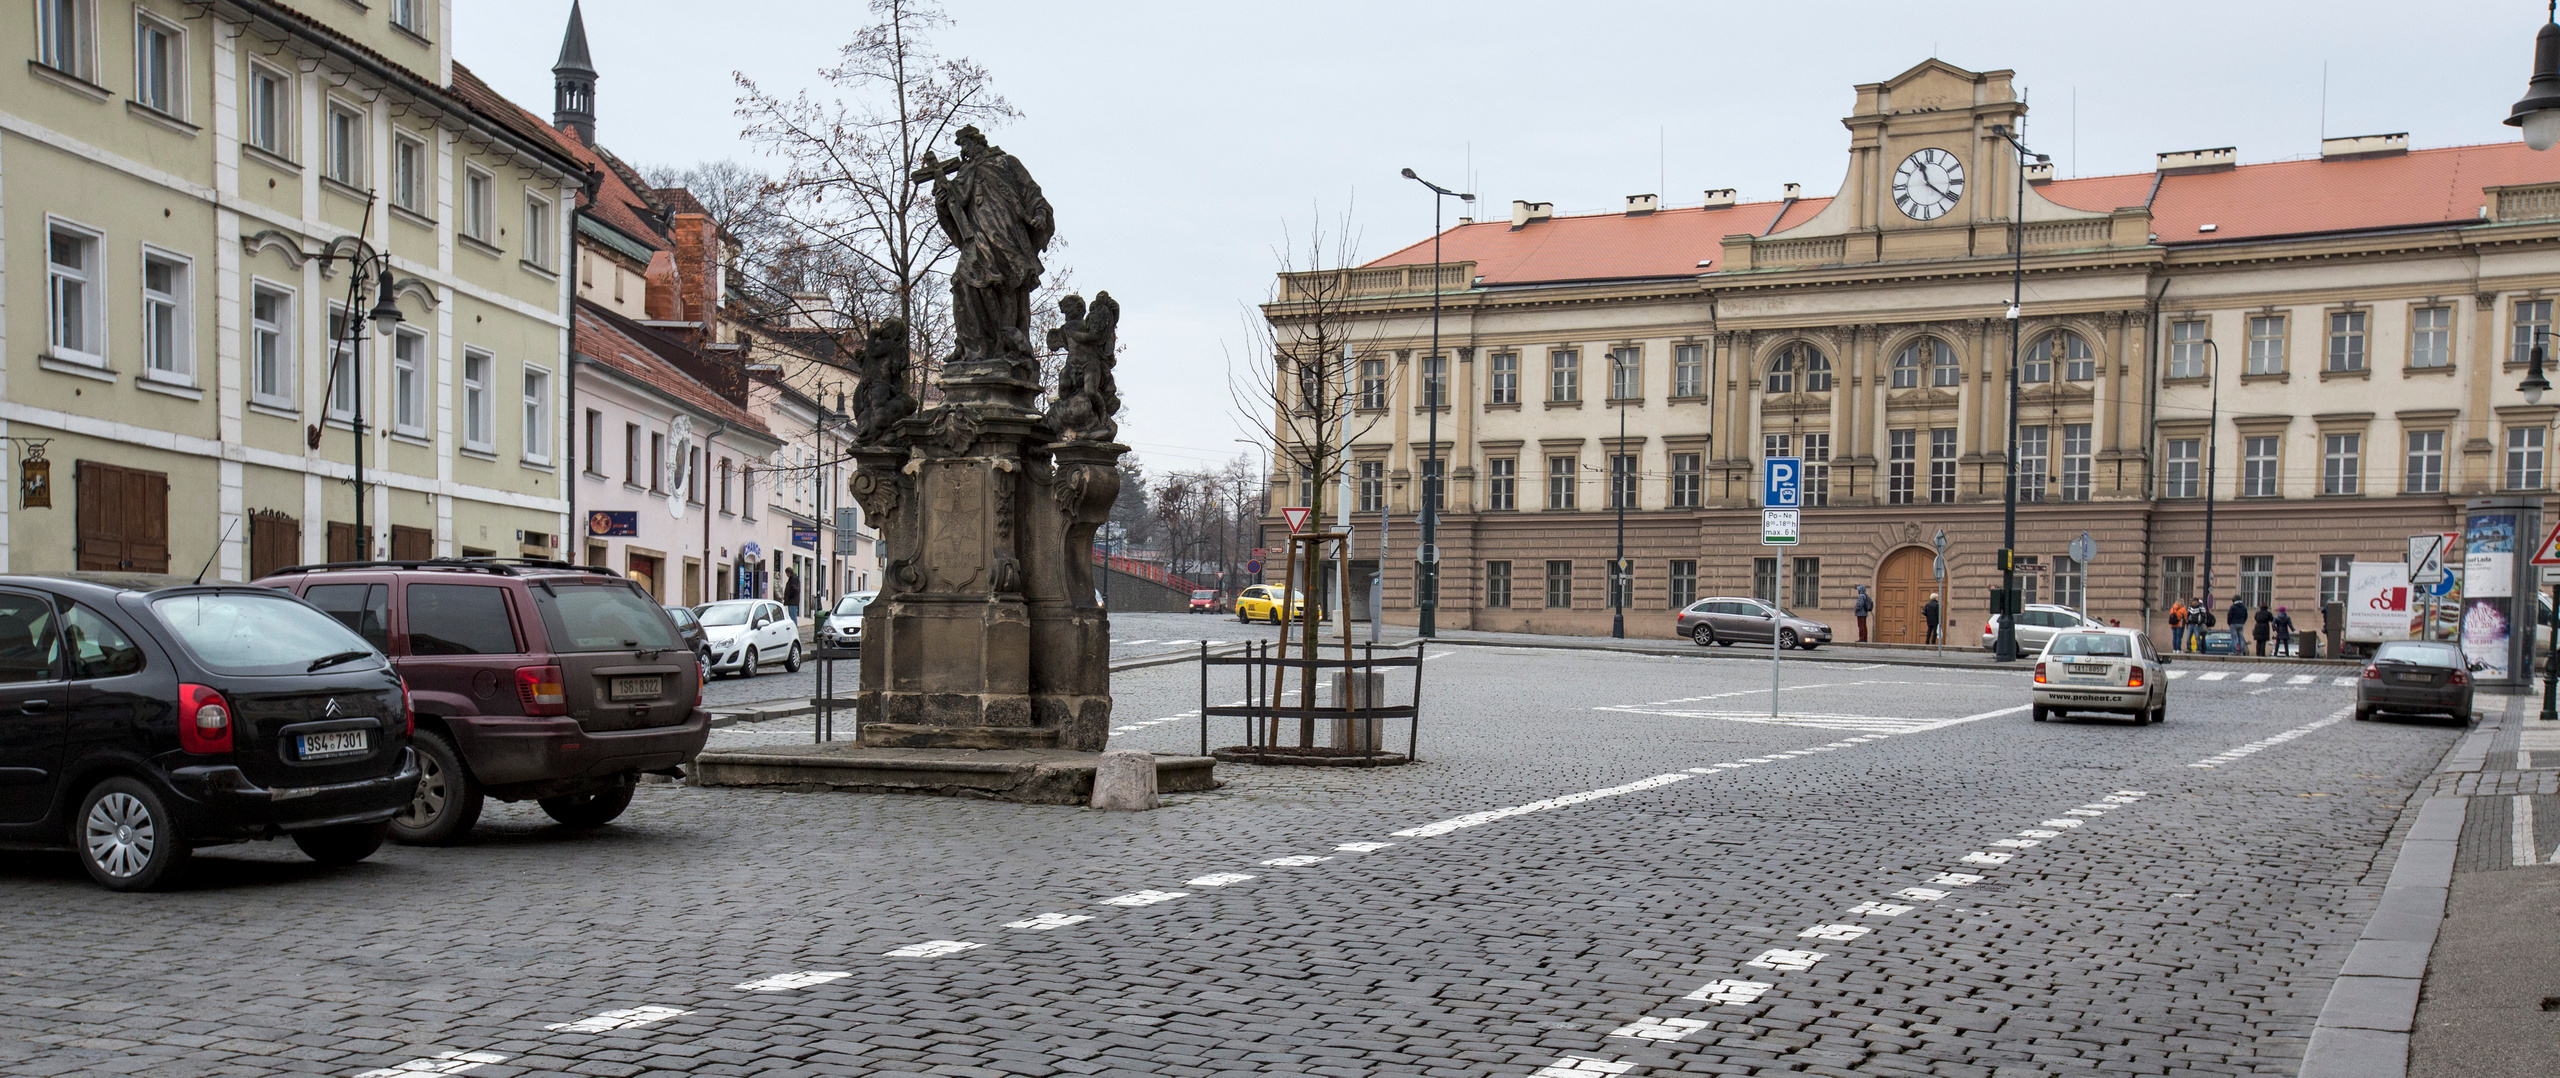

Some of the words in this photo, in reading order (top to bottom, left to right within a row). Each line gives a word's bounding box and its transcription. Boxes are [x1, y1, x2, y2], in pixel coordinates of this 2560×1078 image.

[1772, 464, 1793, 492] P
[744, 541, 761, 559] CHANGE
[619, 680, 634, 694] 1S6
[639, 679, 659, 694] 8322
[2049, 693, 2122, 702] www.proheat.cz
[307, 735, 328, 752] 9S4
[336, 732, 362, 750] 7301
